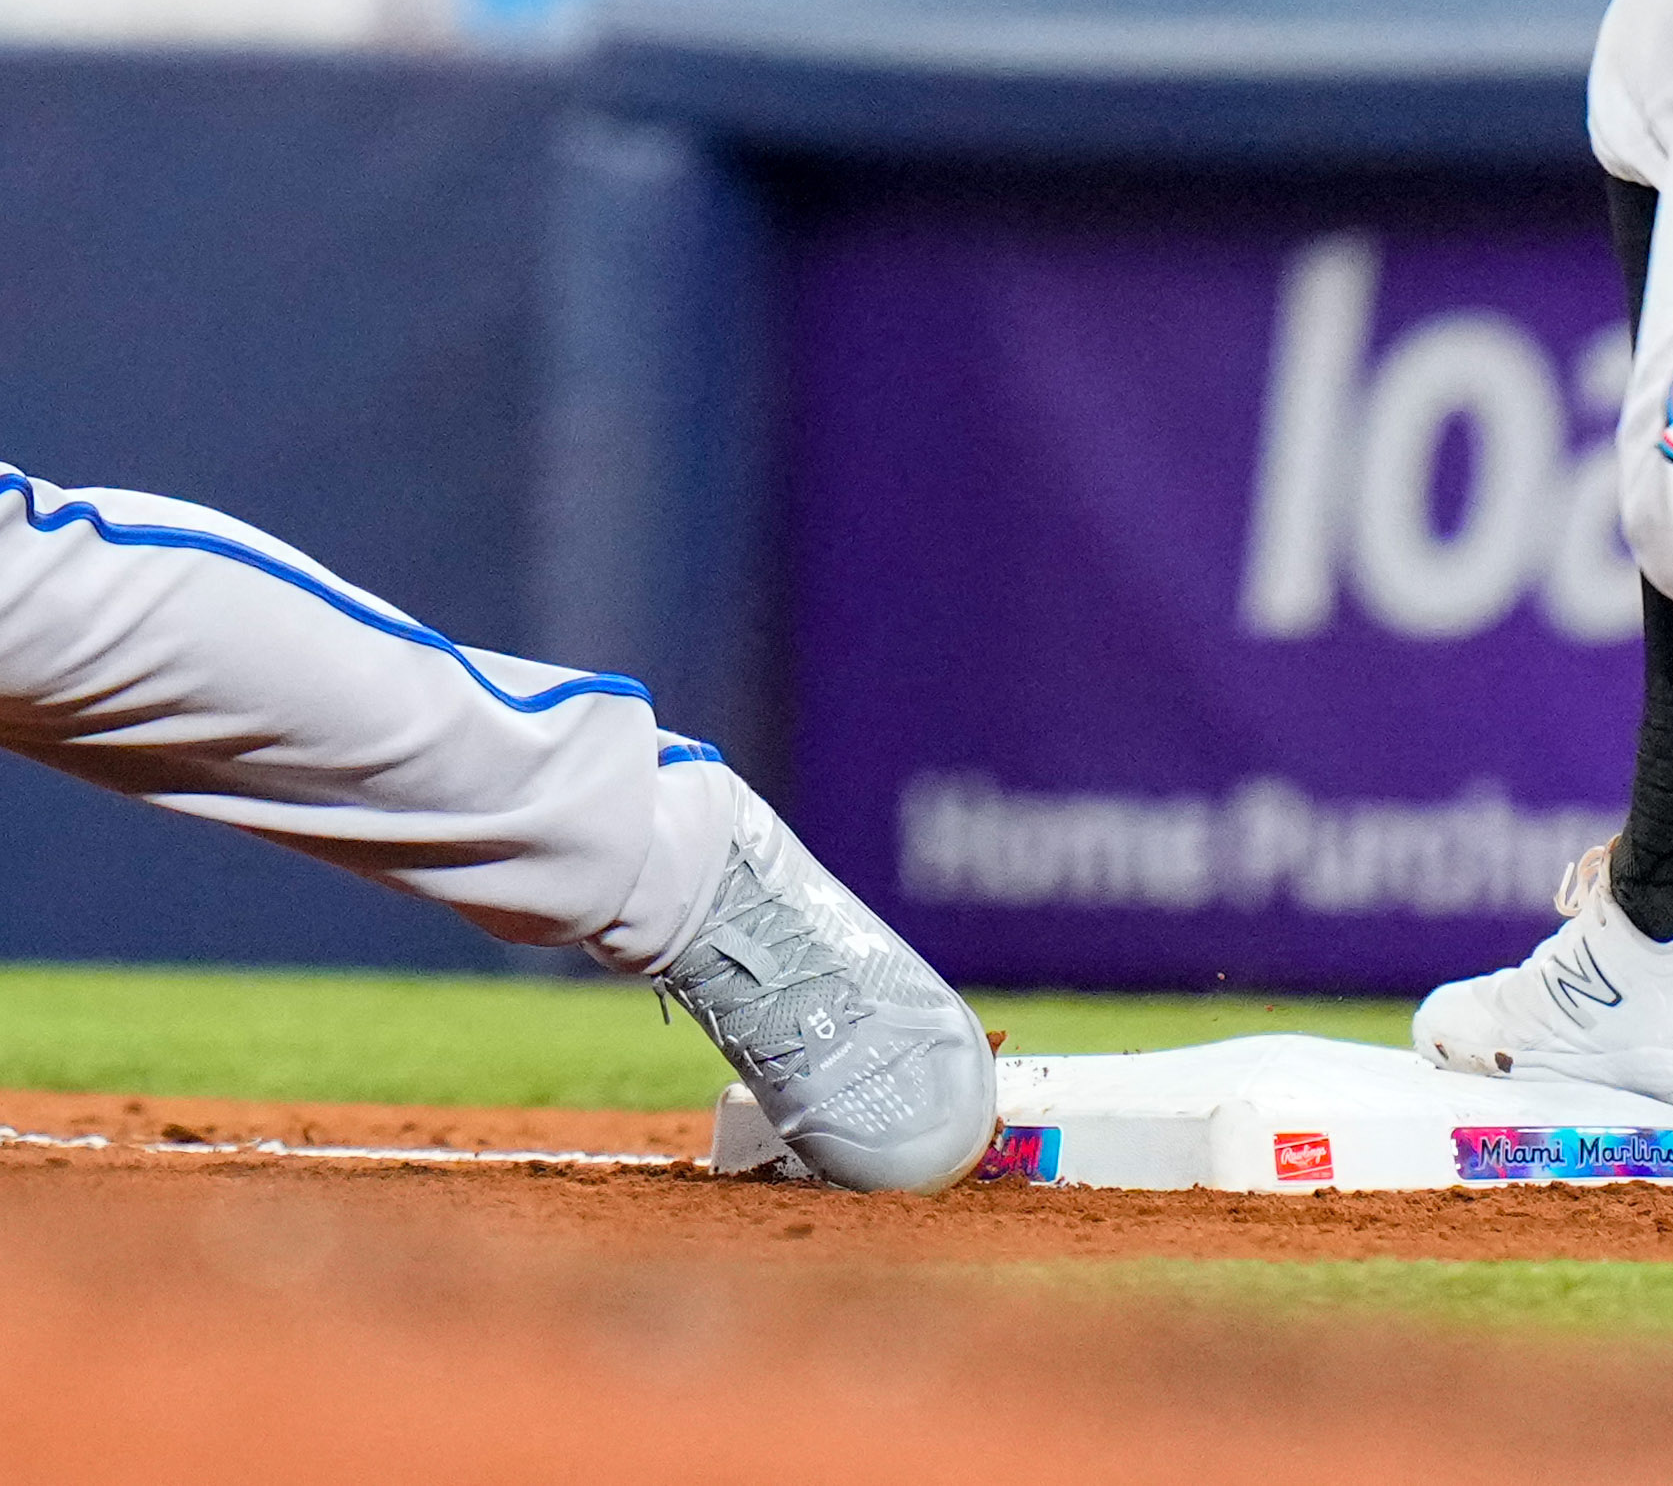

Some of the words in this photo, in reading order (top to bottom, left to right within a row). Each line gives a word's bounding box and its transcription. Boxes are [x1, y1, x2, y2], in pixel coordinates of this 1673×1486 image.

[900, 773, 1208, 909] Home
[1228, 771, 1624, 917] Purcha
[1280, 1144, 1327, 1165] Rawlings
[1477, 1136, 1566, 1169] Miami
